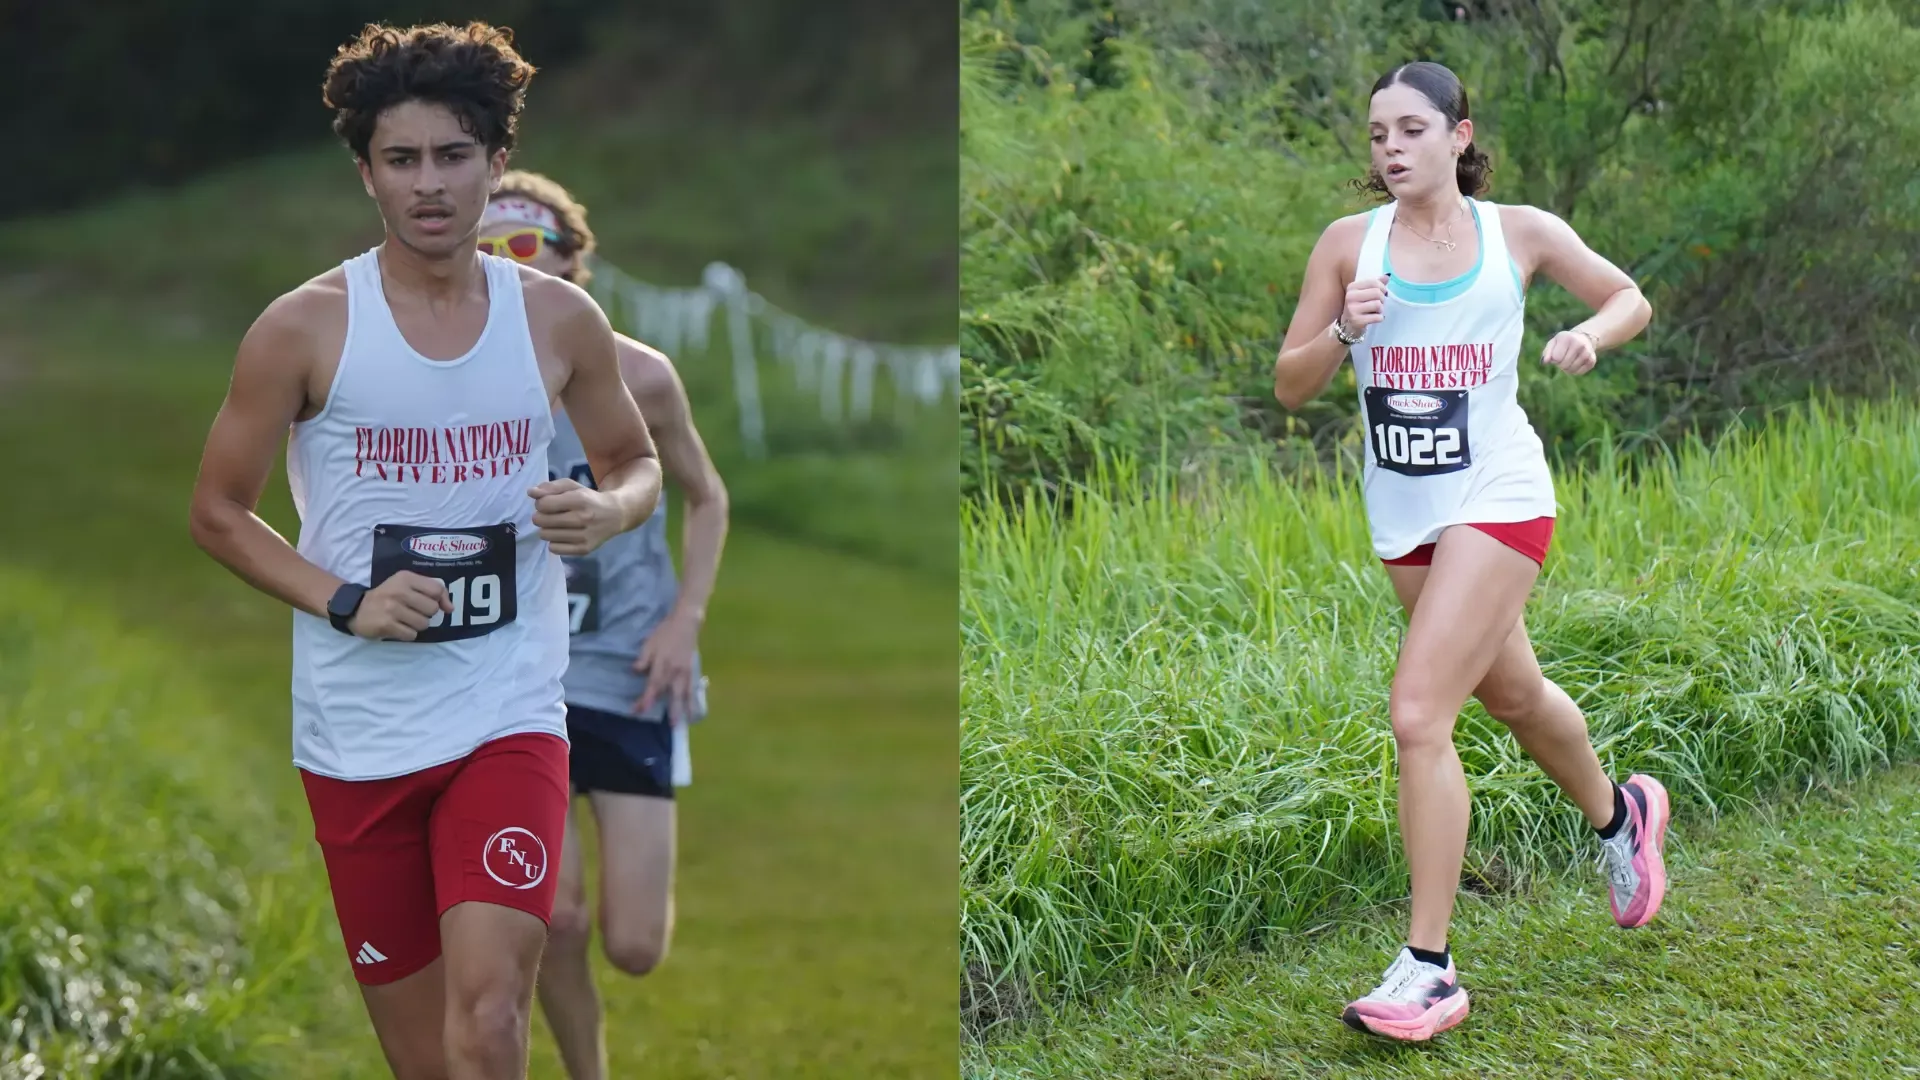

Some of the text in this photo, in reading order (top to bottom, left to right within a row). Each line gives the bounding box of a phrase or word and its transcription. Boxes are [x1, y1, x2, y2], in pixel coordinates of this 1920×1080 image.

[1370, 342, 1494, 374] FLORIDA NATIONAL
[1372, 369, 1491, 390] UNIVERSITY
[1387, 396, 1443, 409] Track Shack
[355, 418, 532, 465] FLORIDA NATIONAL
[1375, 423, 1462, 465] 1022
[355, 454, 531, 484] UNIVERSITY
[410, 537, 489, 552] Track Shack
[498, 837, 540, 880] FNU
